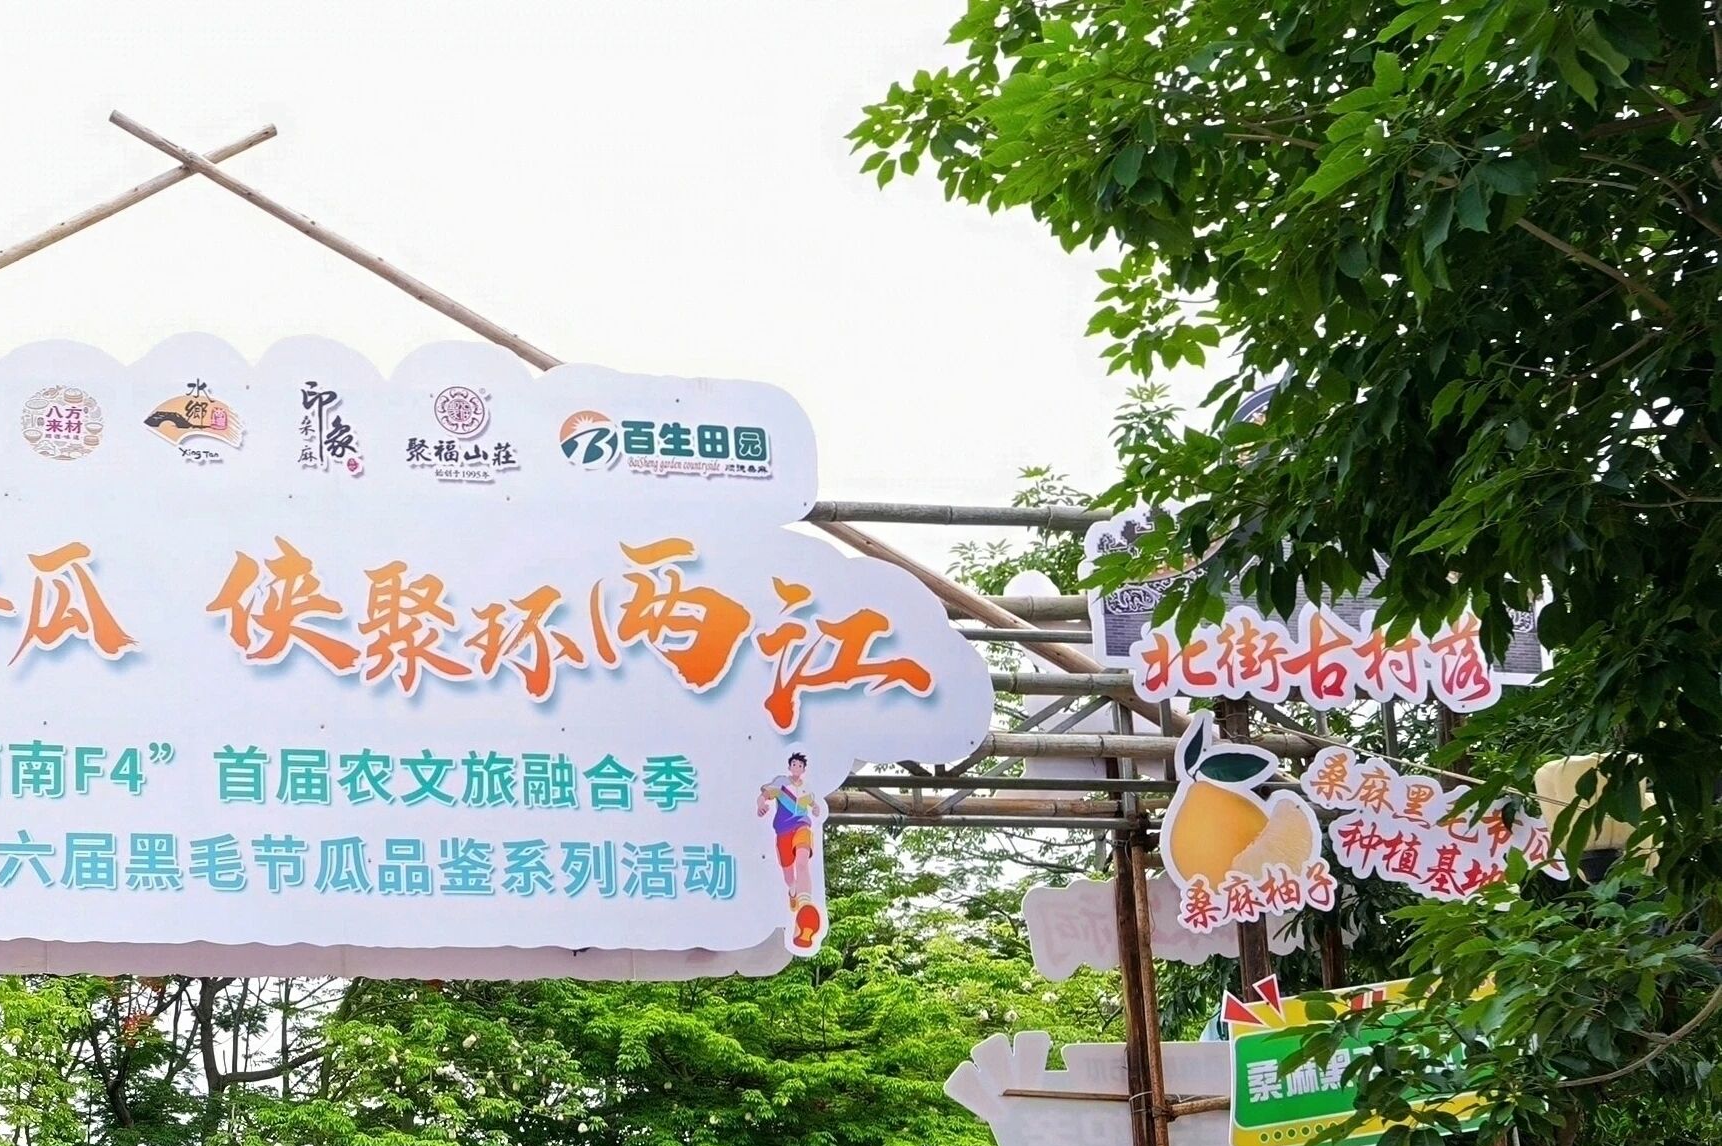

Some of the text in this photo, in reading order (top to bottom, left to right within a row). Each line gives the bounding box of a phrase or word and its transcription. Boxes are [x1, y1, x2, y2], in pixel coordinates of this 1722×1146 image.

[621, 420, 768, 462] 百生田园
[1140, 612, 1492, 702] 北街古村落
[1182, 863, 1336, 928] 桑麻柚子
